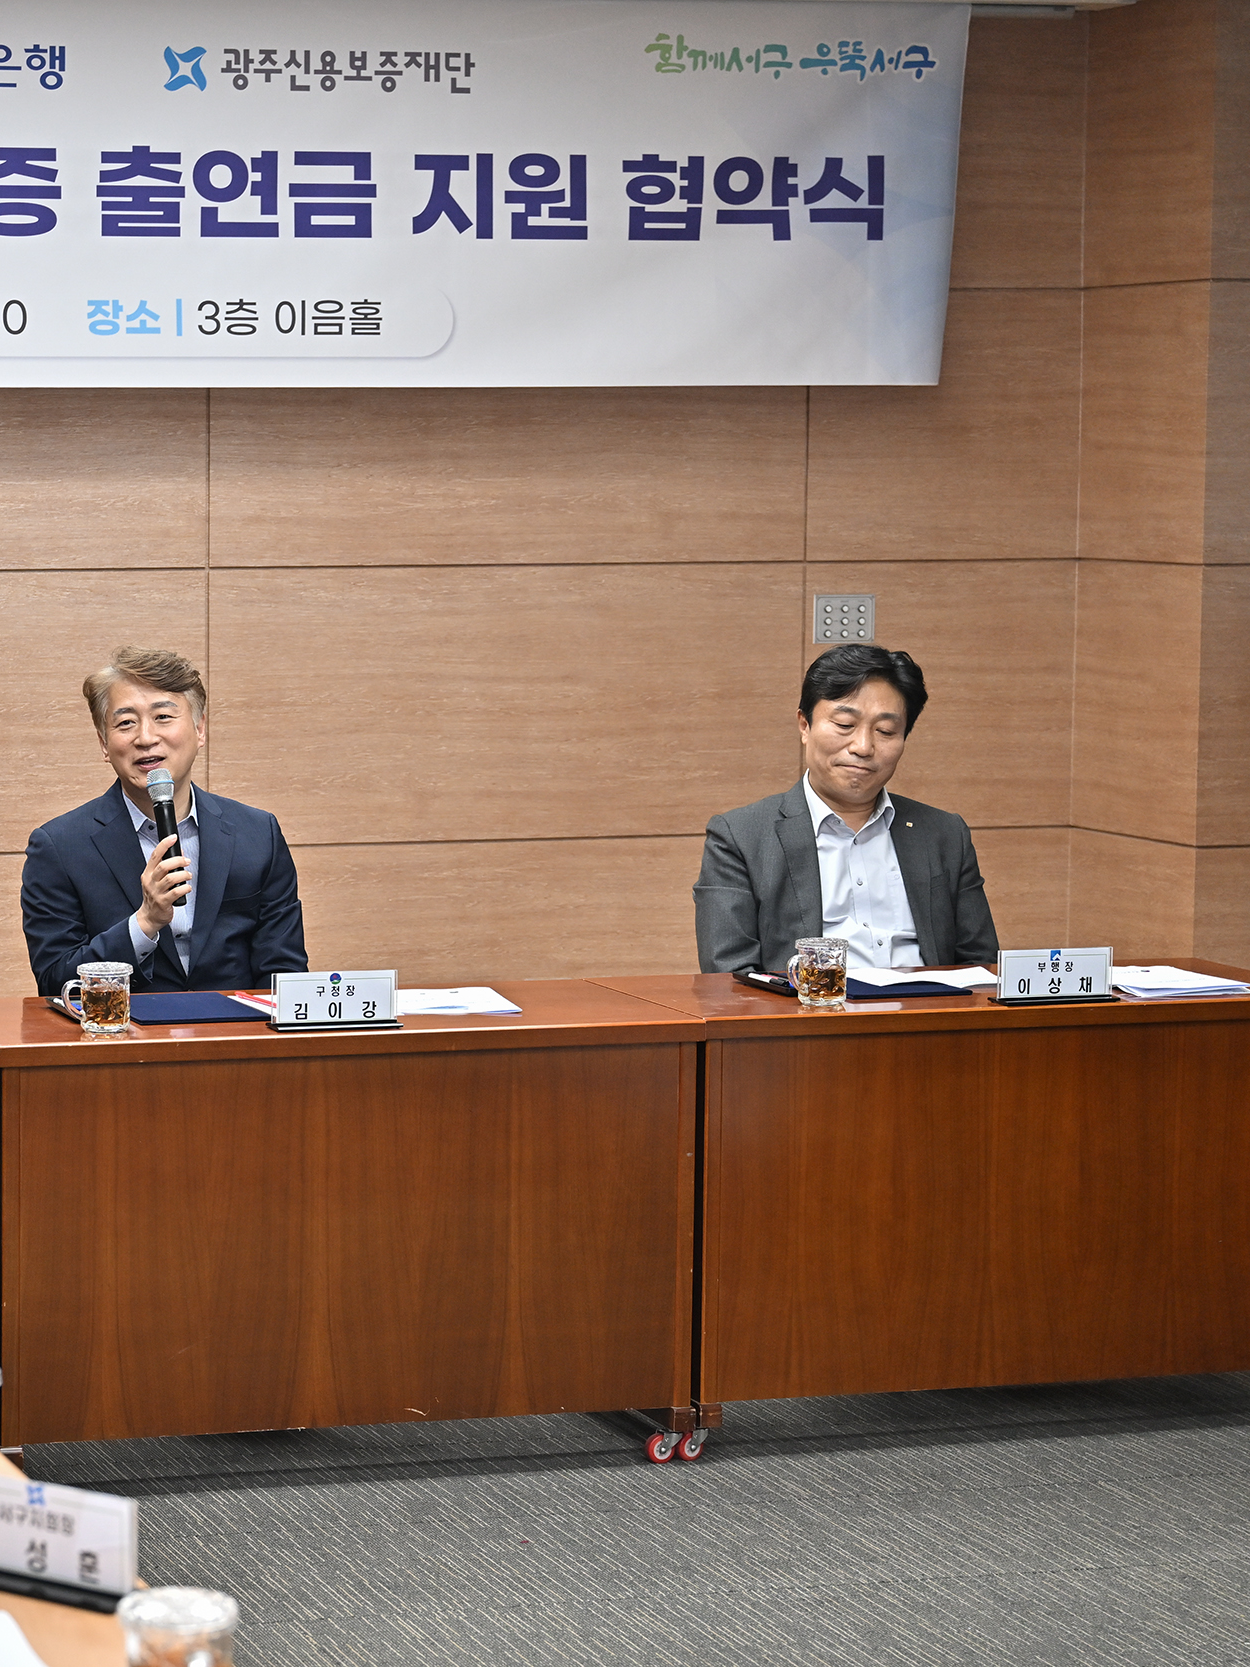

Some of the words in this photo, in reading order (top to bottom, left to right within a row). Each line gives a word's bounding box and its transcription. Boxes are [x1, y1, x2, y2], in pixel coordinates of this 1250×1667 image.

[220, 48, 475, 94] 광주신용보증재단
[644, 33, 793, 80] 함께서구
[799, 41, 937, 82] 우뚝서구
[95, 145, 378, 239] 출연금
[412, 152, 589, 241] 지원
[622, 153, 886, 242] 협약식
[86, 299, 162, 336] 장소
[197, 299, 259, 337] 3층
[274, 298, 383, 336] 이음홀
[1037, 961, 1074, 973] 부행장
[316, 985, 356, 997] 구청장
